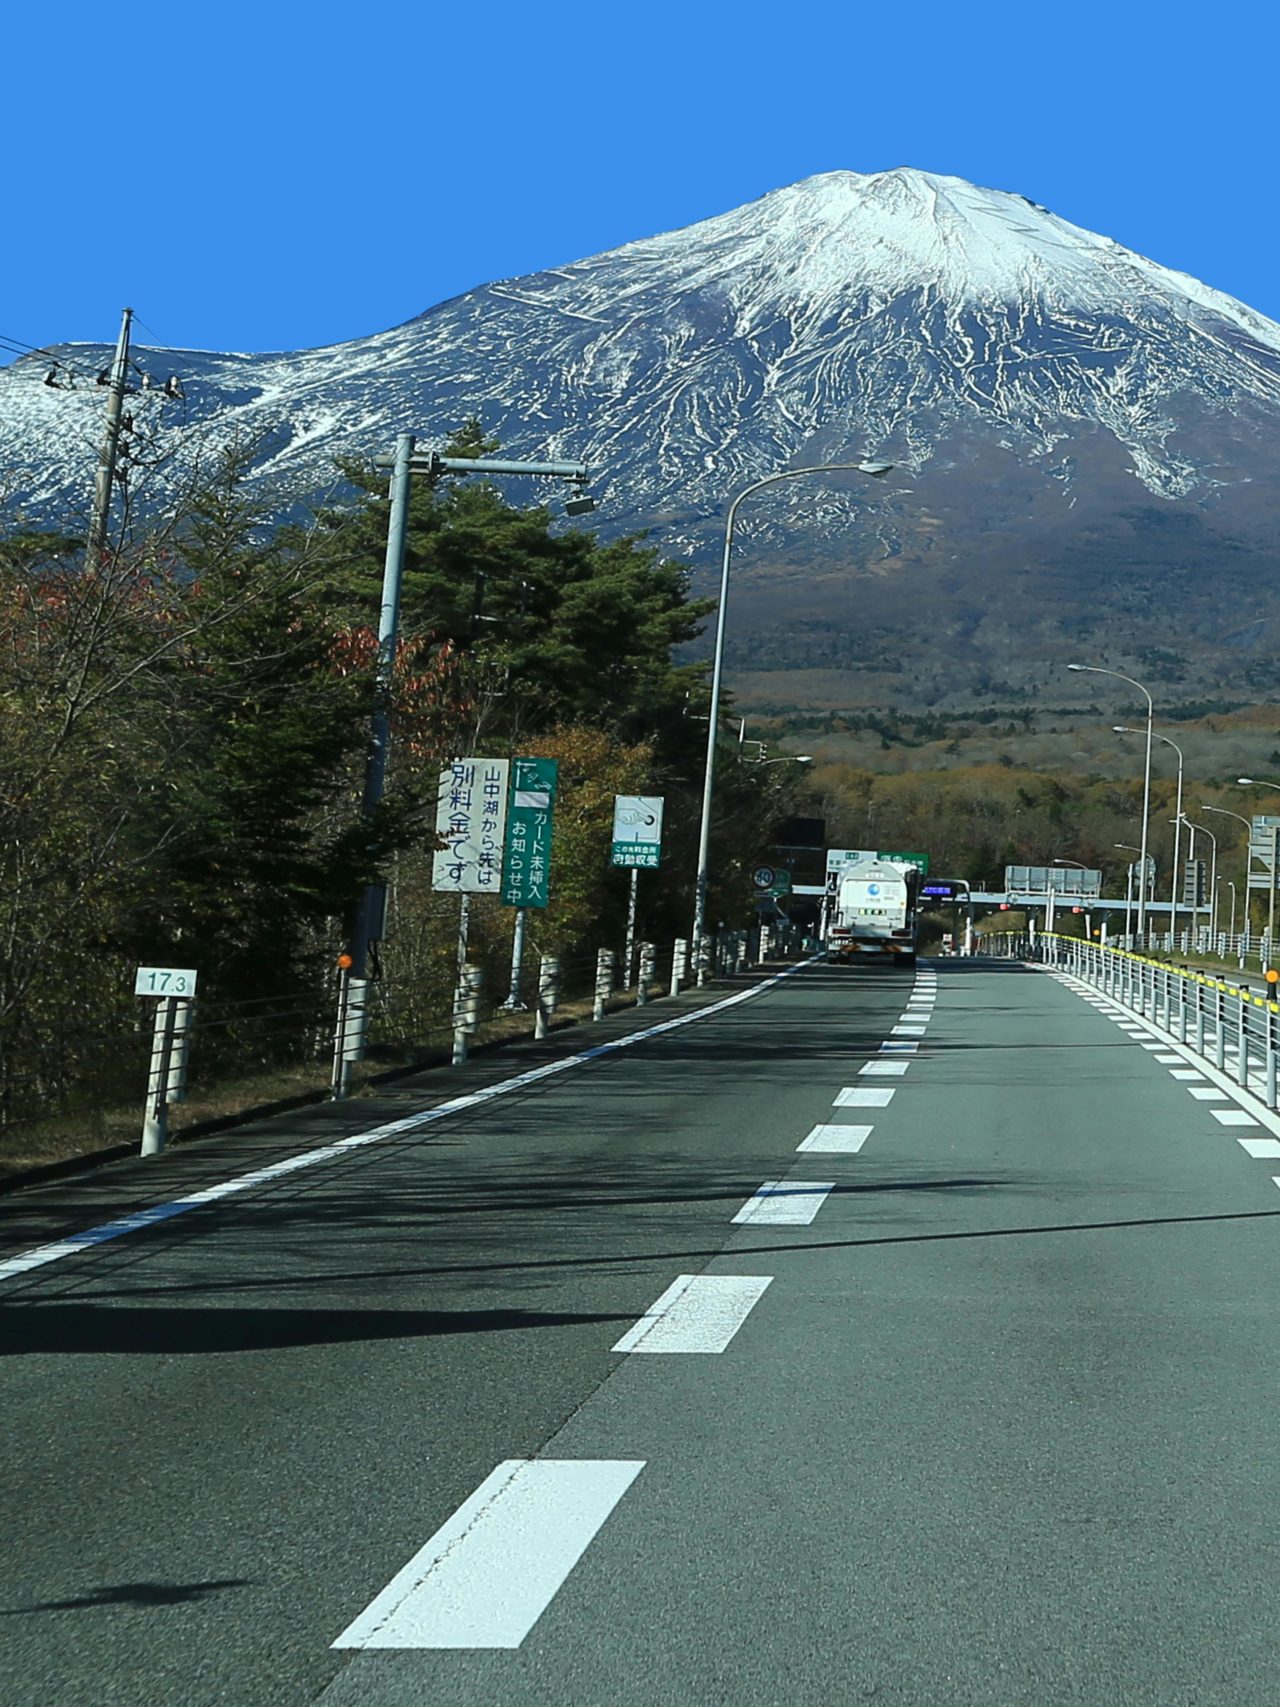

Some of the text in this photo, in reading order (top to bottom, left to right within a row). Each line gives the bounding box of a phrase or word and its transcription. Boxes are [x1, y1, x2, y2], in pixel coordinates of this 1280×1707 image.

[446, 765, 475, 884] 別料金です
[478, 766, 500, 885] 山中湖から先は
[507, 821, 527, 904] お知らせ中
[528, 811, 547, 900] カード未挿入
[148, 972, 186, 992] 17.3
